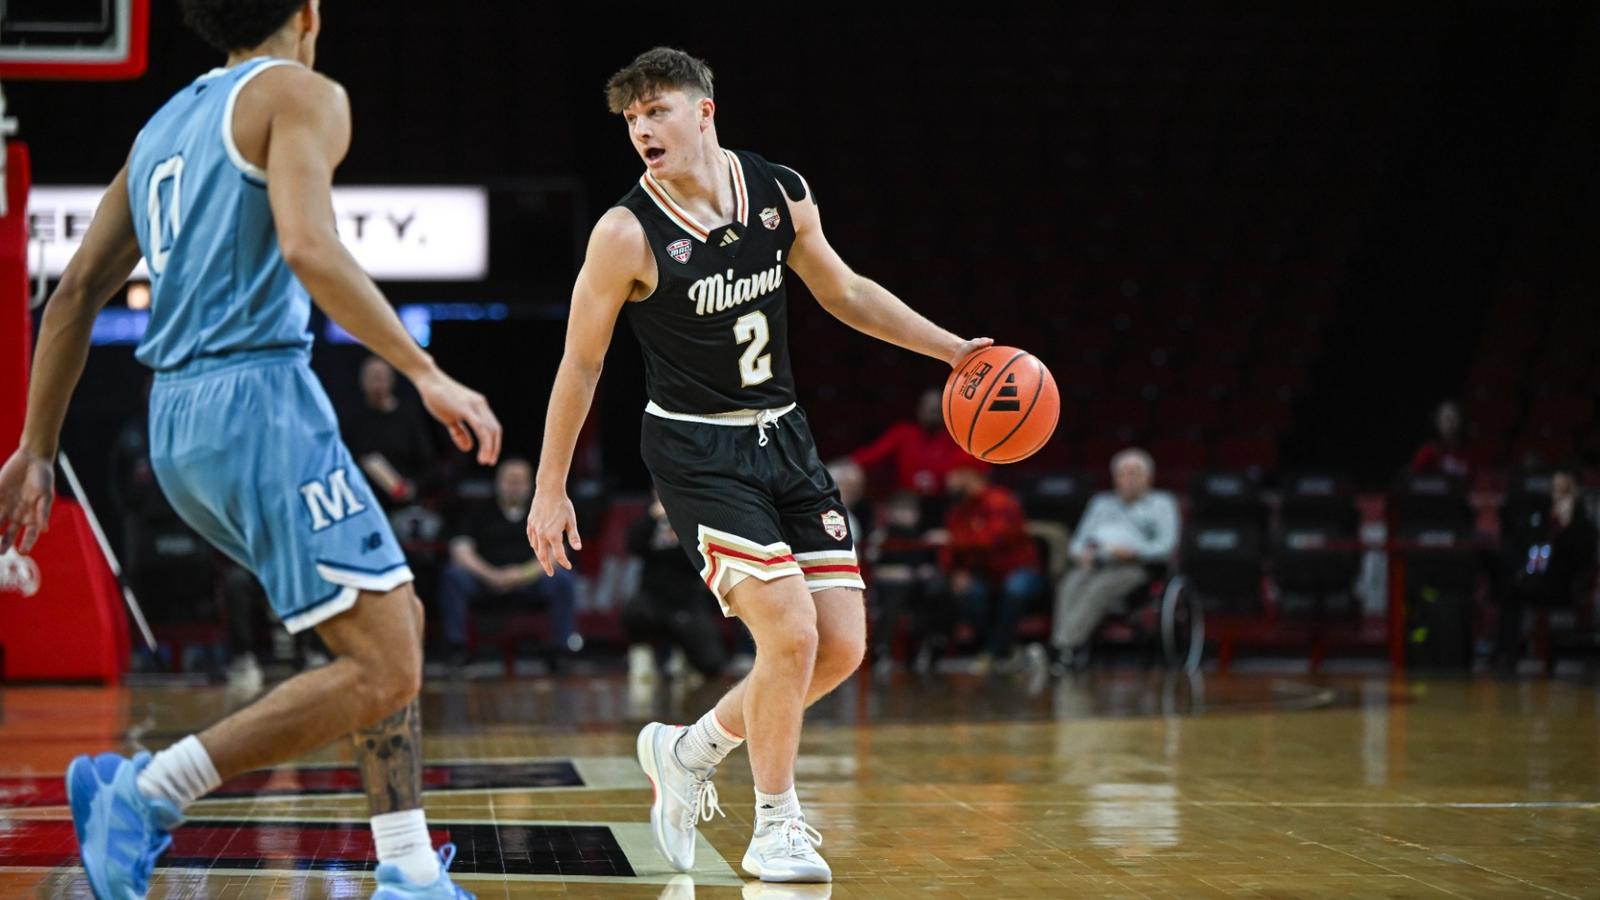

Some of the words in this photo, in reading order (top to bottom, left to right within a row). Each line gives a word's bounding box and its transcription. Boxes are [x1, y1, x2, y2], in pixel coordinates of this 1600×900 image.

[147, 154, 184, 275] 0
[687, 249, 783, 316] Miami
[733, 309, 774, 388] 2
[964, 362, 993, 400] PRO
[299, 467, 367, 533] M
